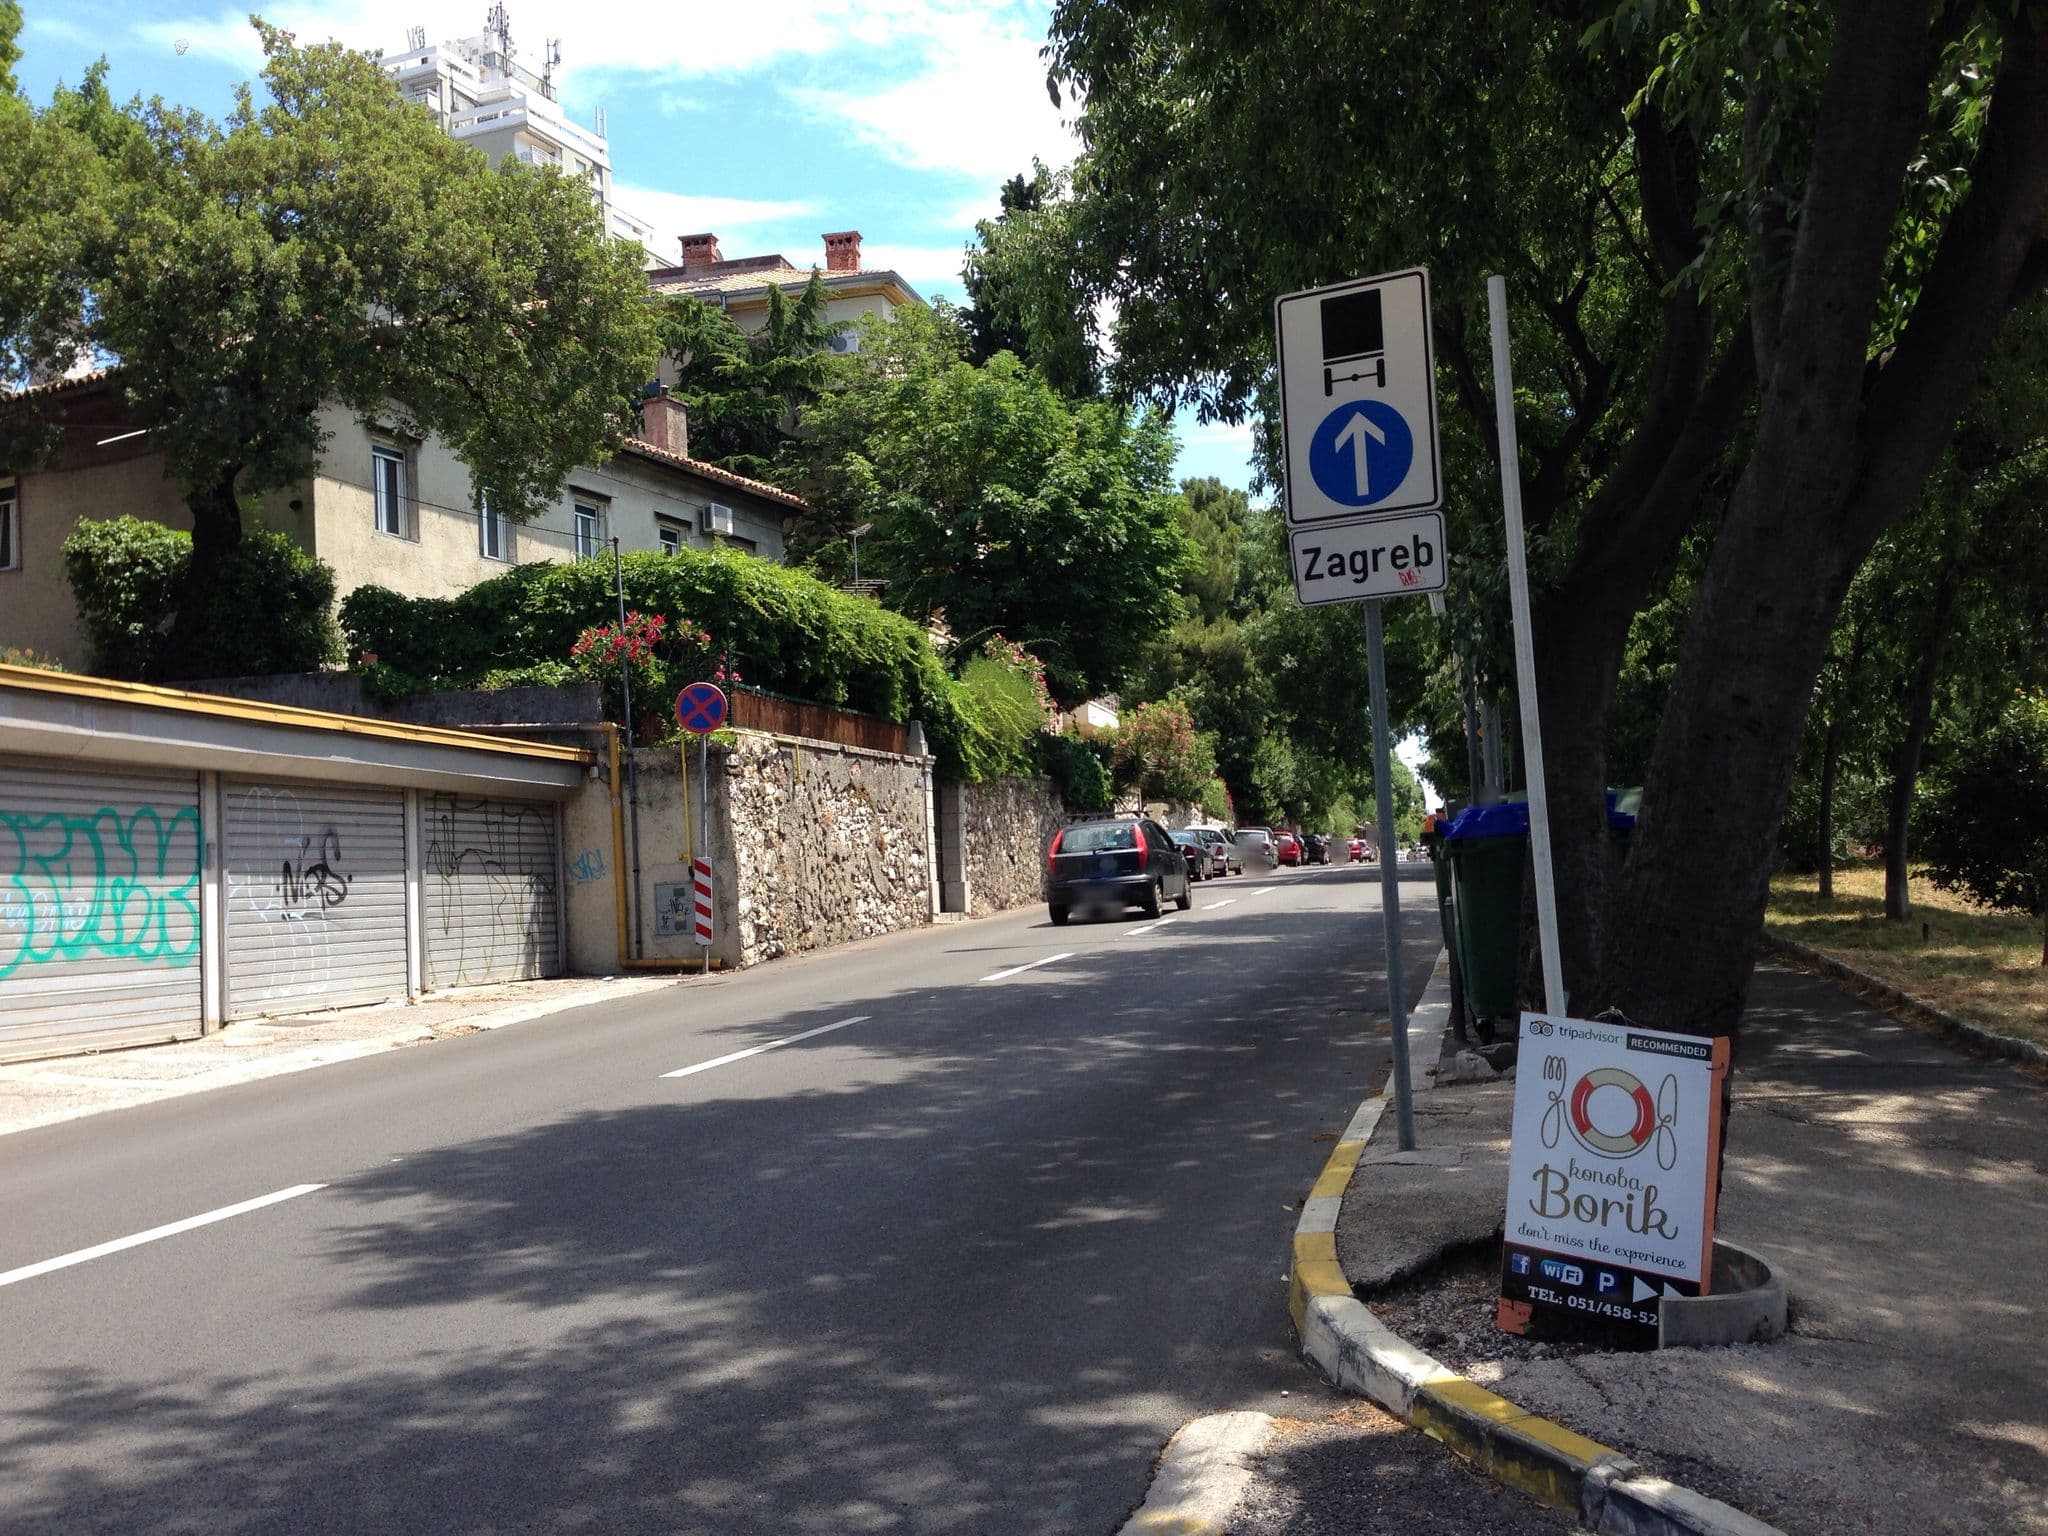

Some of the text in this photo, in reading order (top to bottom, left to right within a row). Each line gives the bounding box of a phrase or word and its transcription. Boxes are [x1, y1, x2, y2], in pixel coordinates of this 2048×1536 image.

[1302, 534, 1434, 584] Zagreb
[1559, 1026, 1707, 1058] tripadvisor RECOMMENDED
[1569, 1158, 1644, 1192] konoba
[1529, 1163, 1679, 1240] Borik
[1554, 1233, 1584, 1248] miss
[1589, 1237, 1611, 1254] the
[1614, 1246, 1687, 1270] experience
[1528, 1285, 1563, 1304] TEL:
[1544, 1266, 1580, 1283] WiFi
[1599, 1272, 1615, 1292] P
